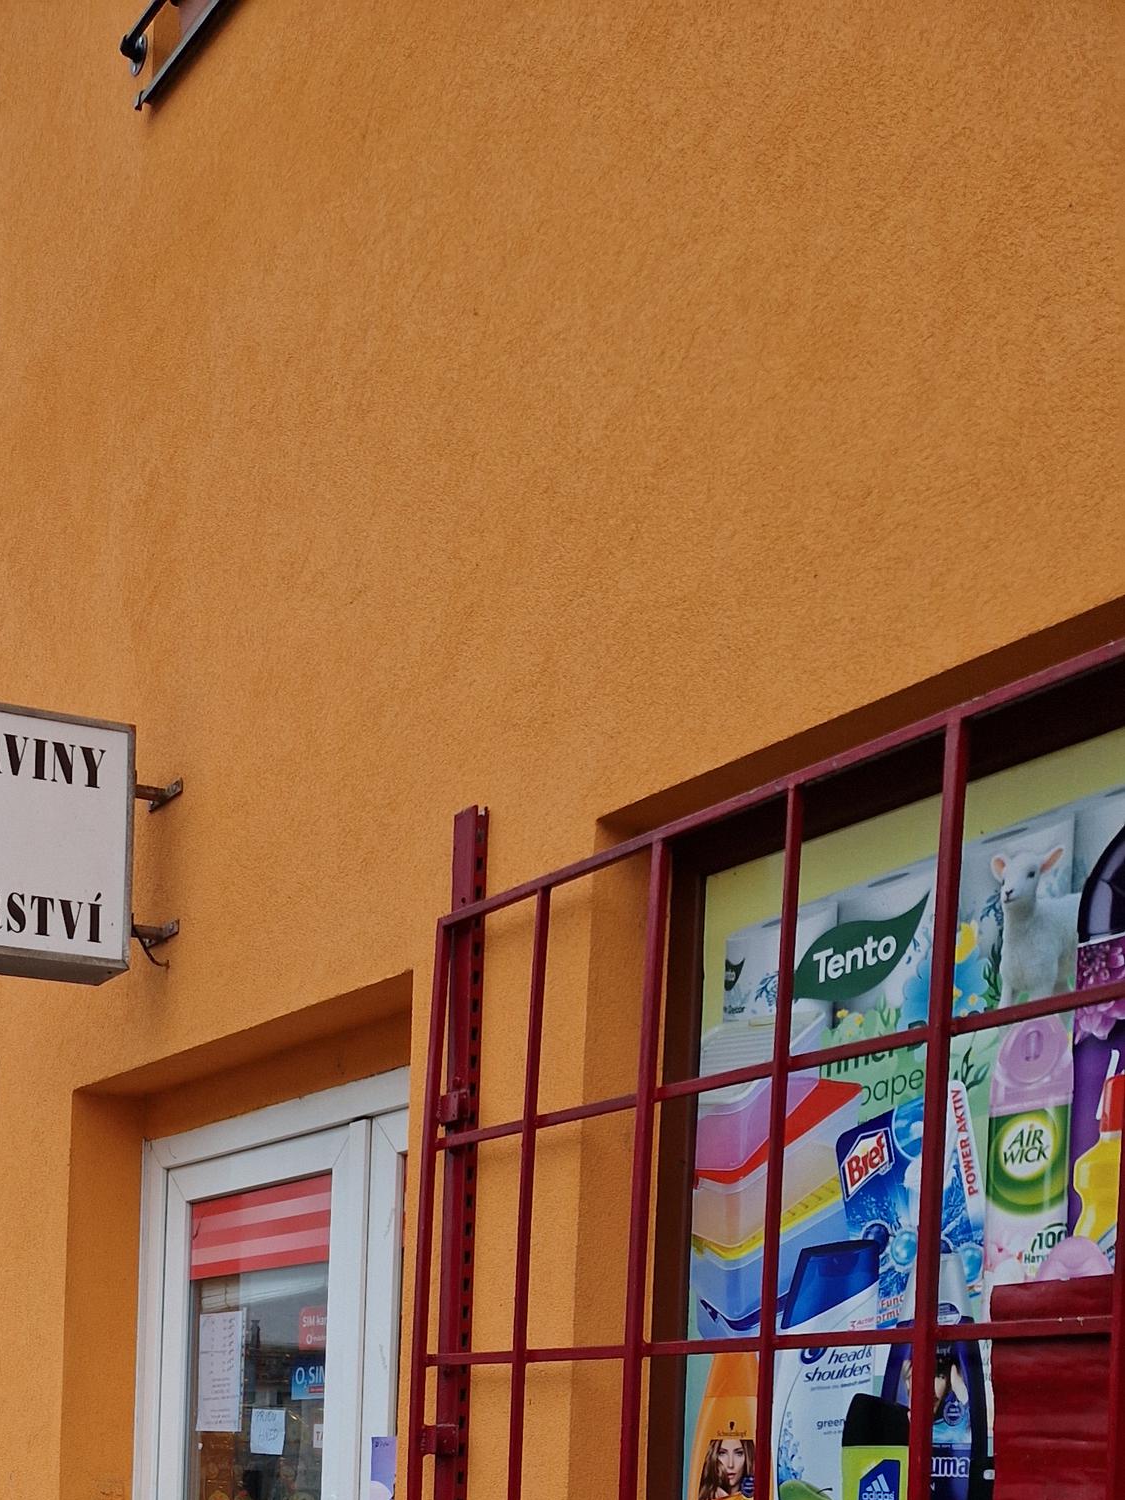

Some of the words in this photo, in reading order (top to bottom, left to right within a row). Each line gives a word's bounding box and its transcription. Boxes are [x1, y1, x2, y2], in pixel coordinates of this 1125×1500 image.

[813, 935, 896, 984] Tento
[845, 1130, 886, 1188] Bref
[957, 1133, 979, 1196] POWER
[1004, 1145, 1050, 1166] WICK
[803, 1363, 871, 1382] shoulders
[862, 1491, 894, 1500] adidas
